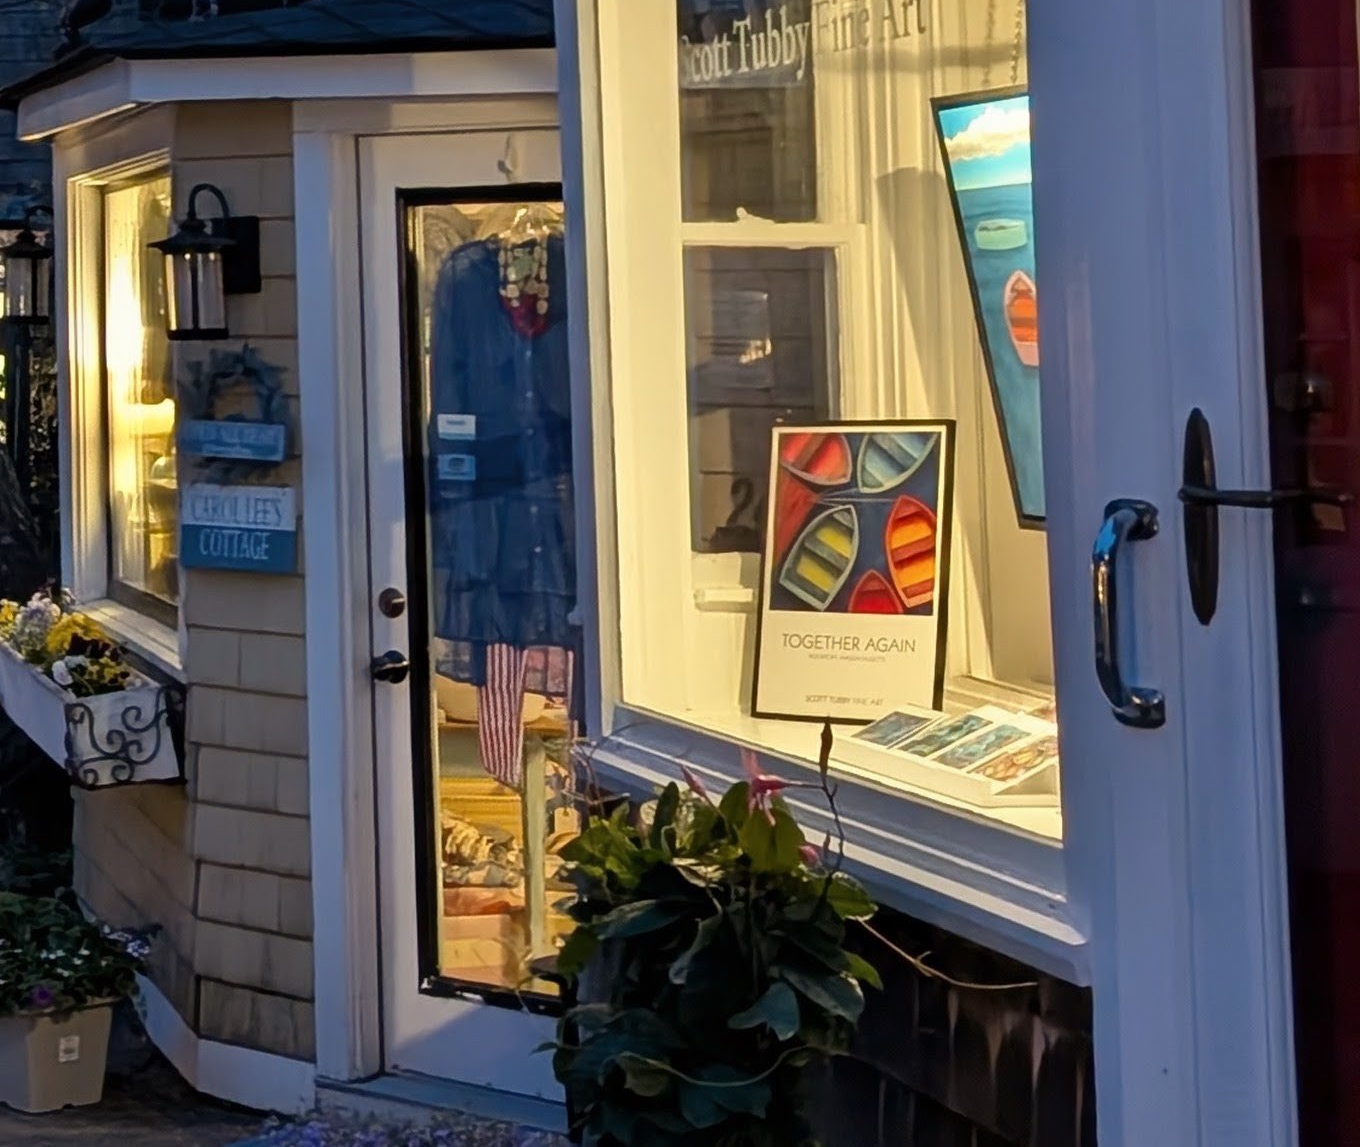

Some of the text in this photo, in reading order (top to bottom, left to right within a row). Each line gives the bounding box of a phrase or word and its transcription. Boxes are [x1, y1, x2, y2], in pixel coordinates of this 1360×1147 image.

[733, 4, 811, 81] Tubby
[191, 494, 242, 524] CAROL
[199, 528, 271, 560] COTTAGE
[782, 633, 916, 653] TOGETHER AGAIN
